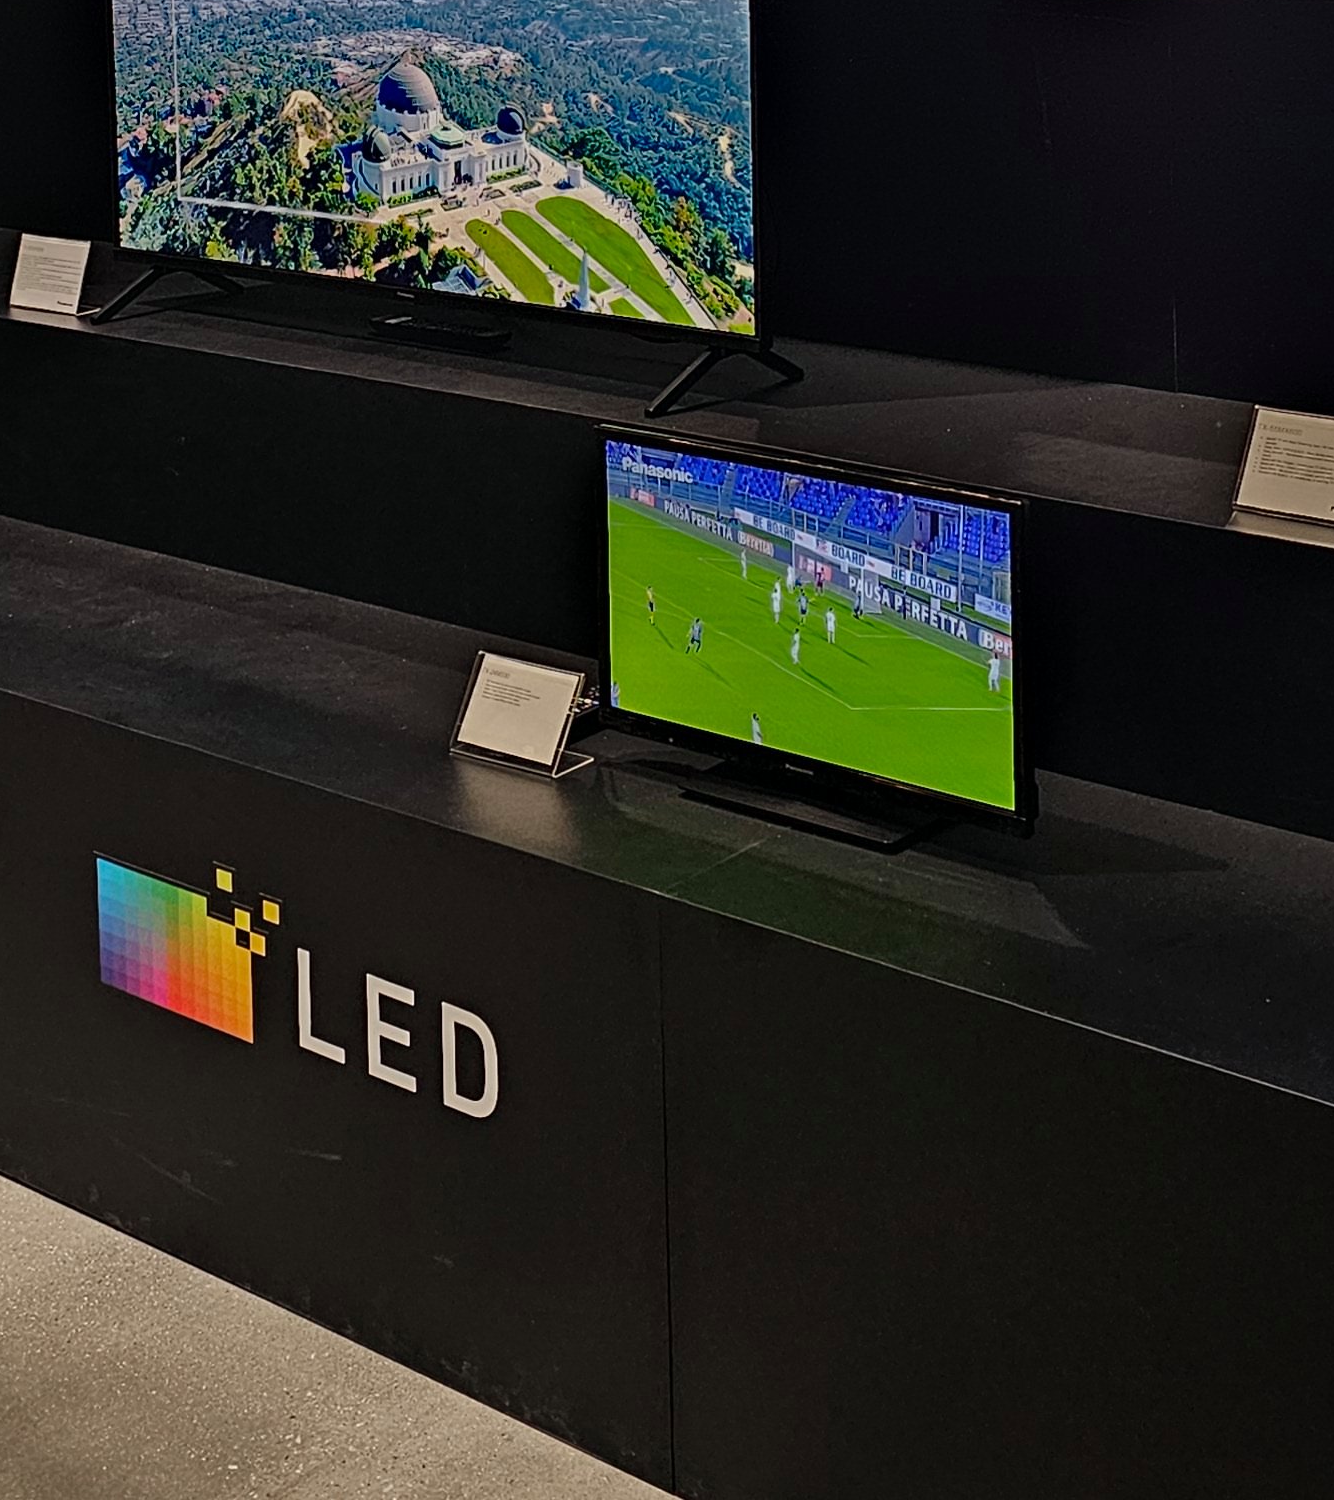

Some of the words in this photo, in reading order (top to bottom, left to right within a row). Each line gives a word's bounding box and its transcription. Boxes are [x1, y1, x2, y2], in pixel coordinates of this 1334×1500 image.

[621, 456, 694, 484] Panasonic
[664, 499, 691, 524] PAUSA
[691, 511, 734, 542] PERFETTA
[753, 514, 764, 529] BE
[767, 517, 796, 541] BOARD
[831, 544, 866, 567] BOARD
[891, 566, 906, 583] BE
[910, 569, 952, 600] BOARD
[848, 575, 892, 611] PAUSA
[894, 591, 968, 642] PERFETTA
[297, 947, 499, 1118] LED
